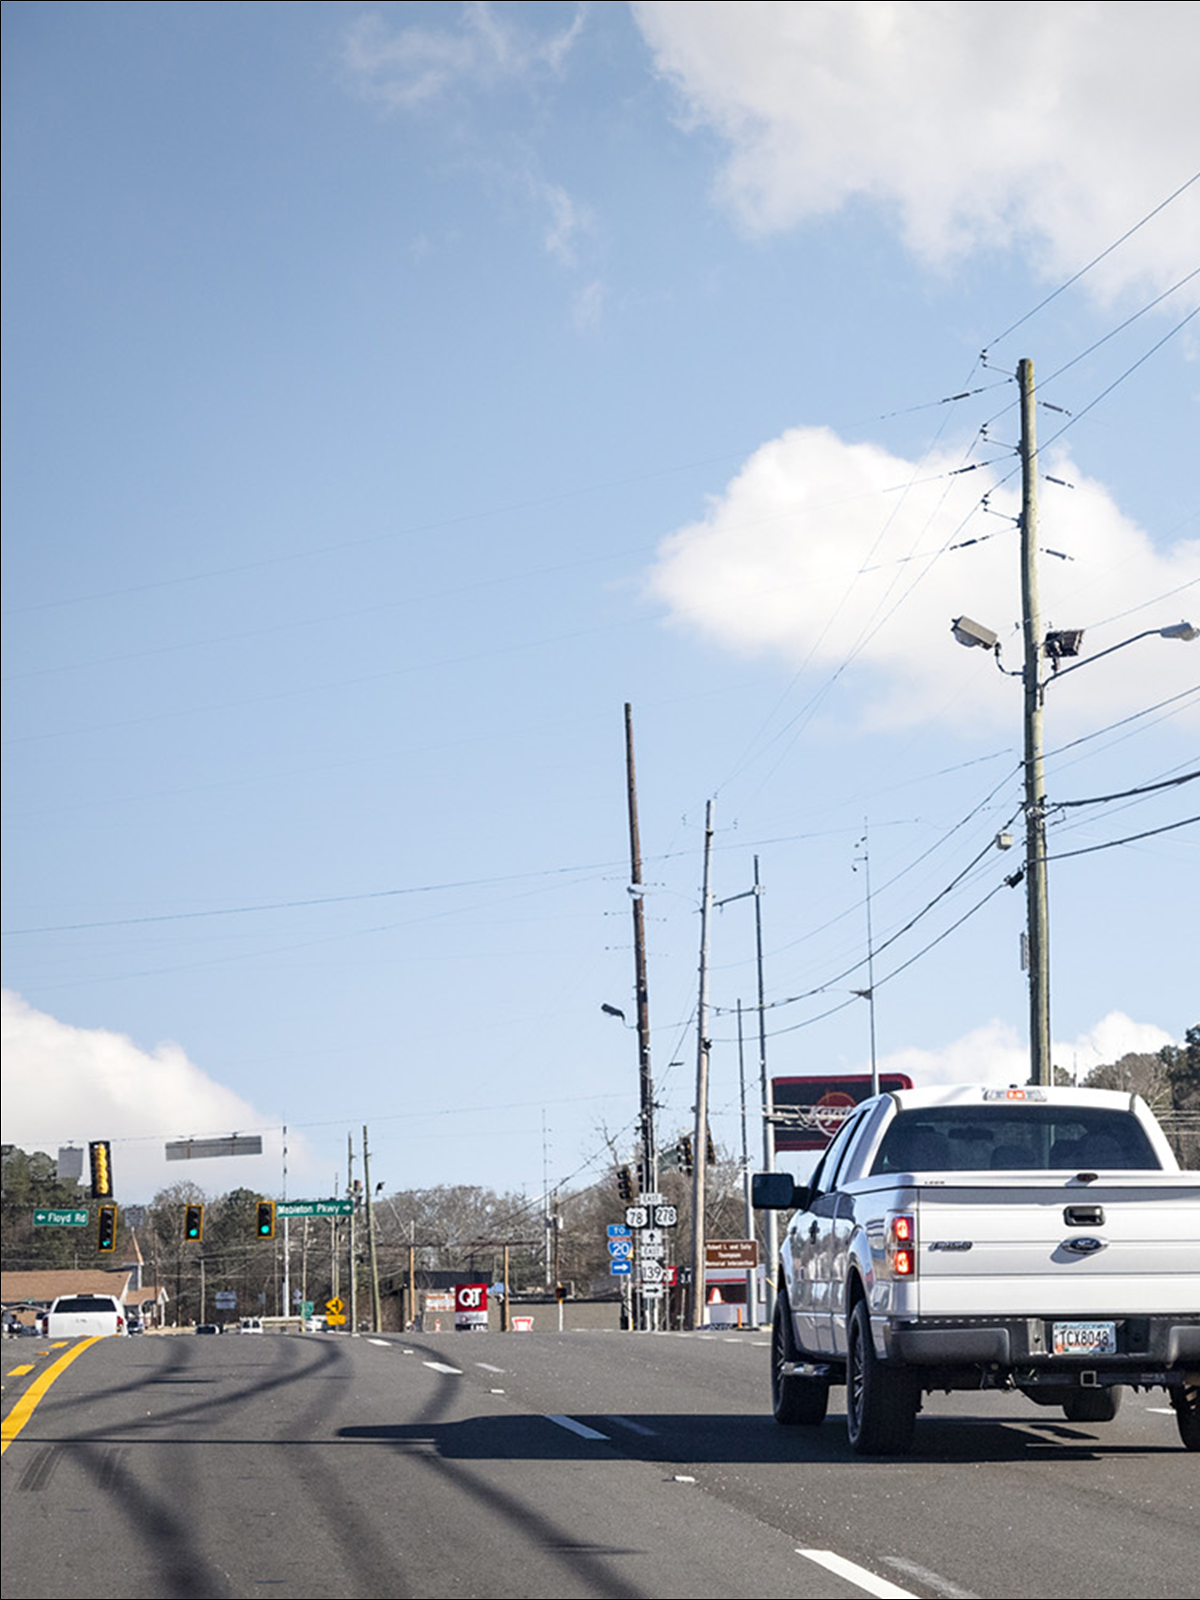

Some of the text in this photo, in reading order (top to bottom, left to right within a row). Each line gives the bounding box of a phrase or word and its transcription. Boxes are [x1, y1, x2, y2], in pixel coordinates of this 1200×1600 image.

[278, 1203, 340, 1214] Mableton Pkwy
[48, 1213, 87, 1225] Floyd Rd
[630, 1212, 643, 1224] 78
[657, 1209, 674, 1222] 278
[613, 1243, 629, 1255] 20
[643, 1266, 660, 1280] 139
[459, 1287, 483, 1307] QT
[1060, 1330, 1109, 1346] TCX8048
